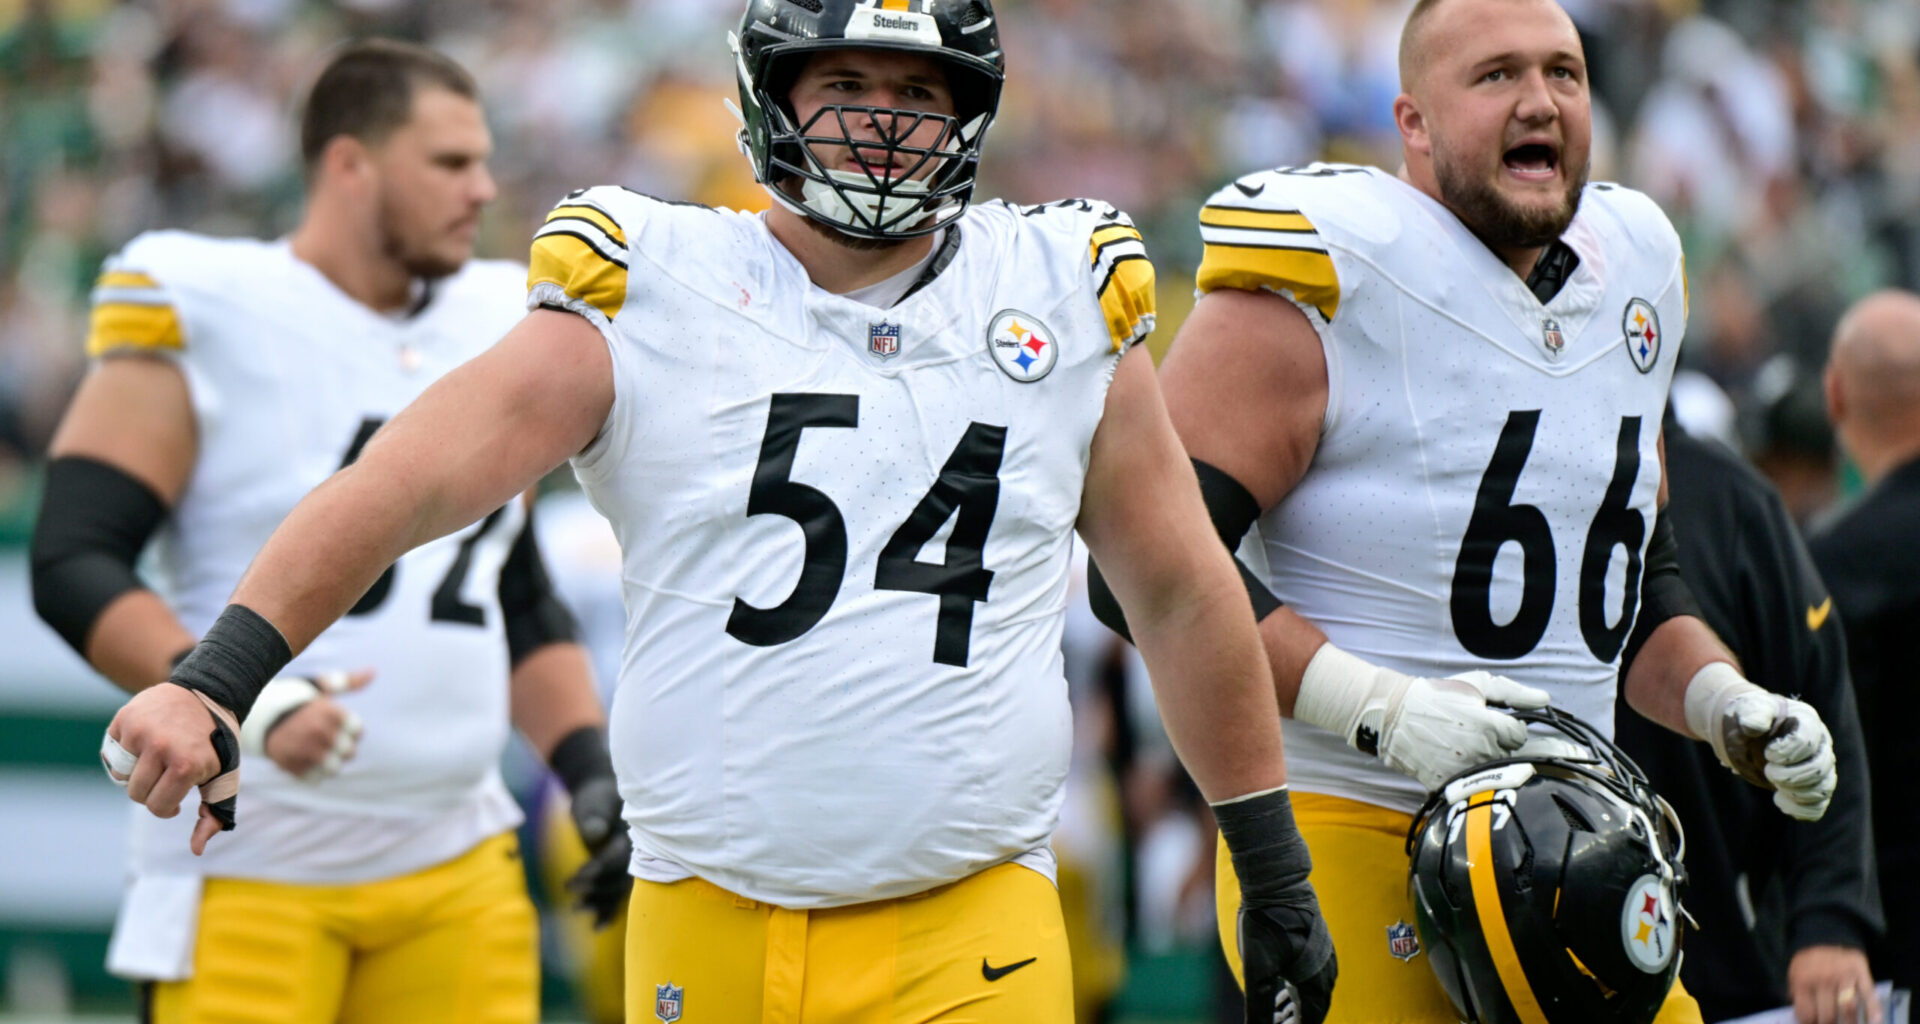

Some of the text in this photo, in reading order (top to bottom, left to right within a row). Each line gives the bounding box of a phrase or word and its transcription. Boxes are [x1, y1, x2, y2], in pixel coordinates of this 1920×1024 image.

[873, 14, 919, 31] Steelers
[873, 336, 897, 353] NFL
[725, 393, 1008, 668] 54
[1450, 409, 1646, 664] 66
[659, 1000, 677, 1016] NFL
